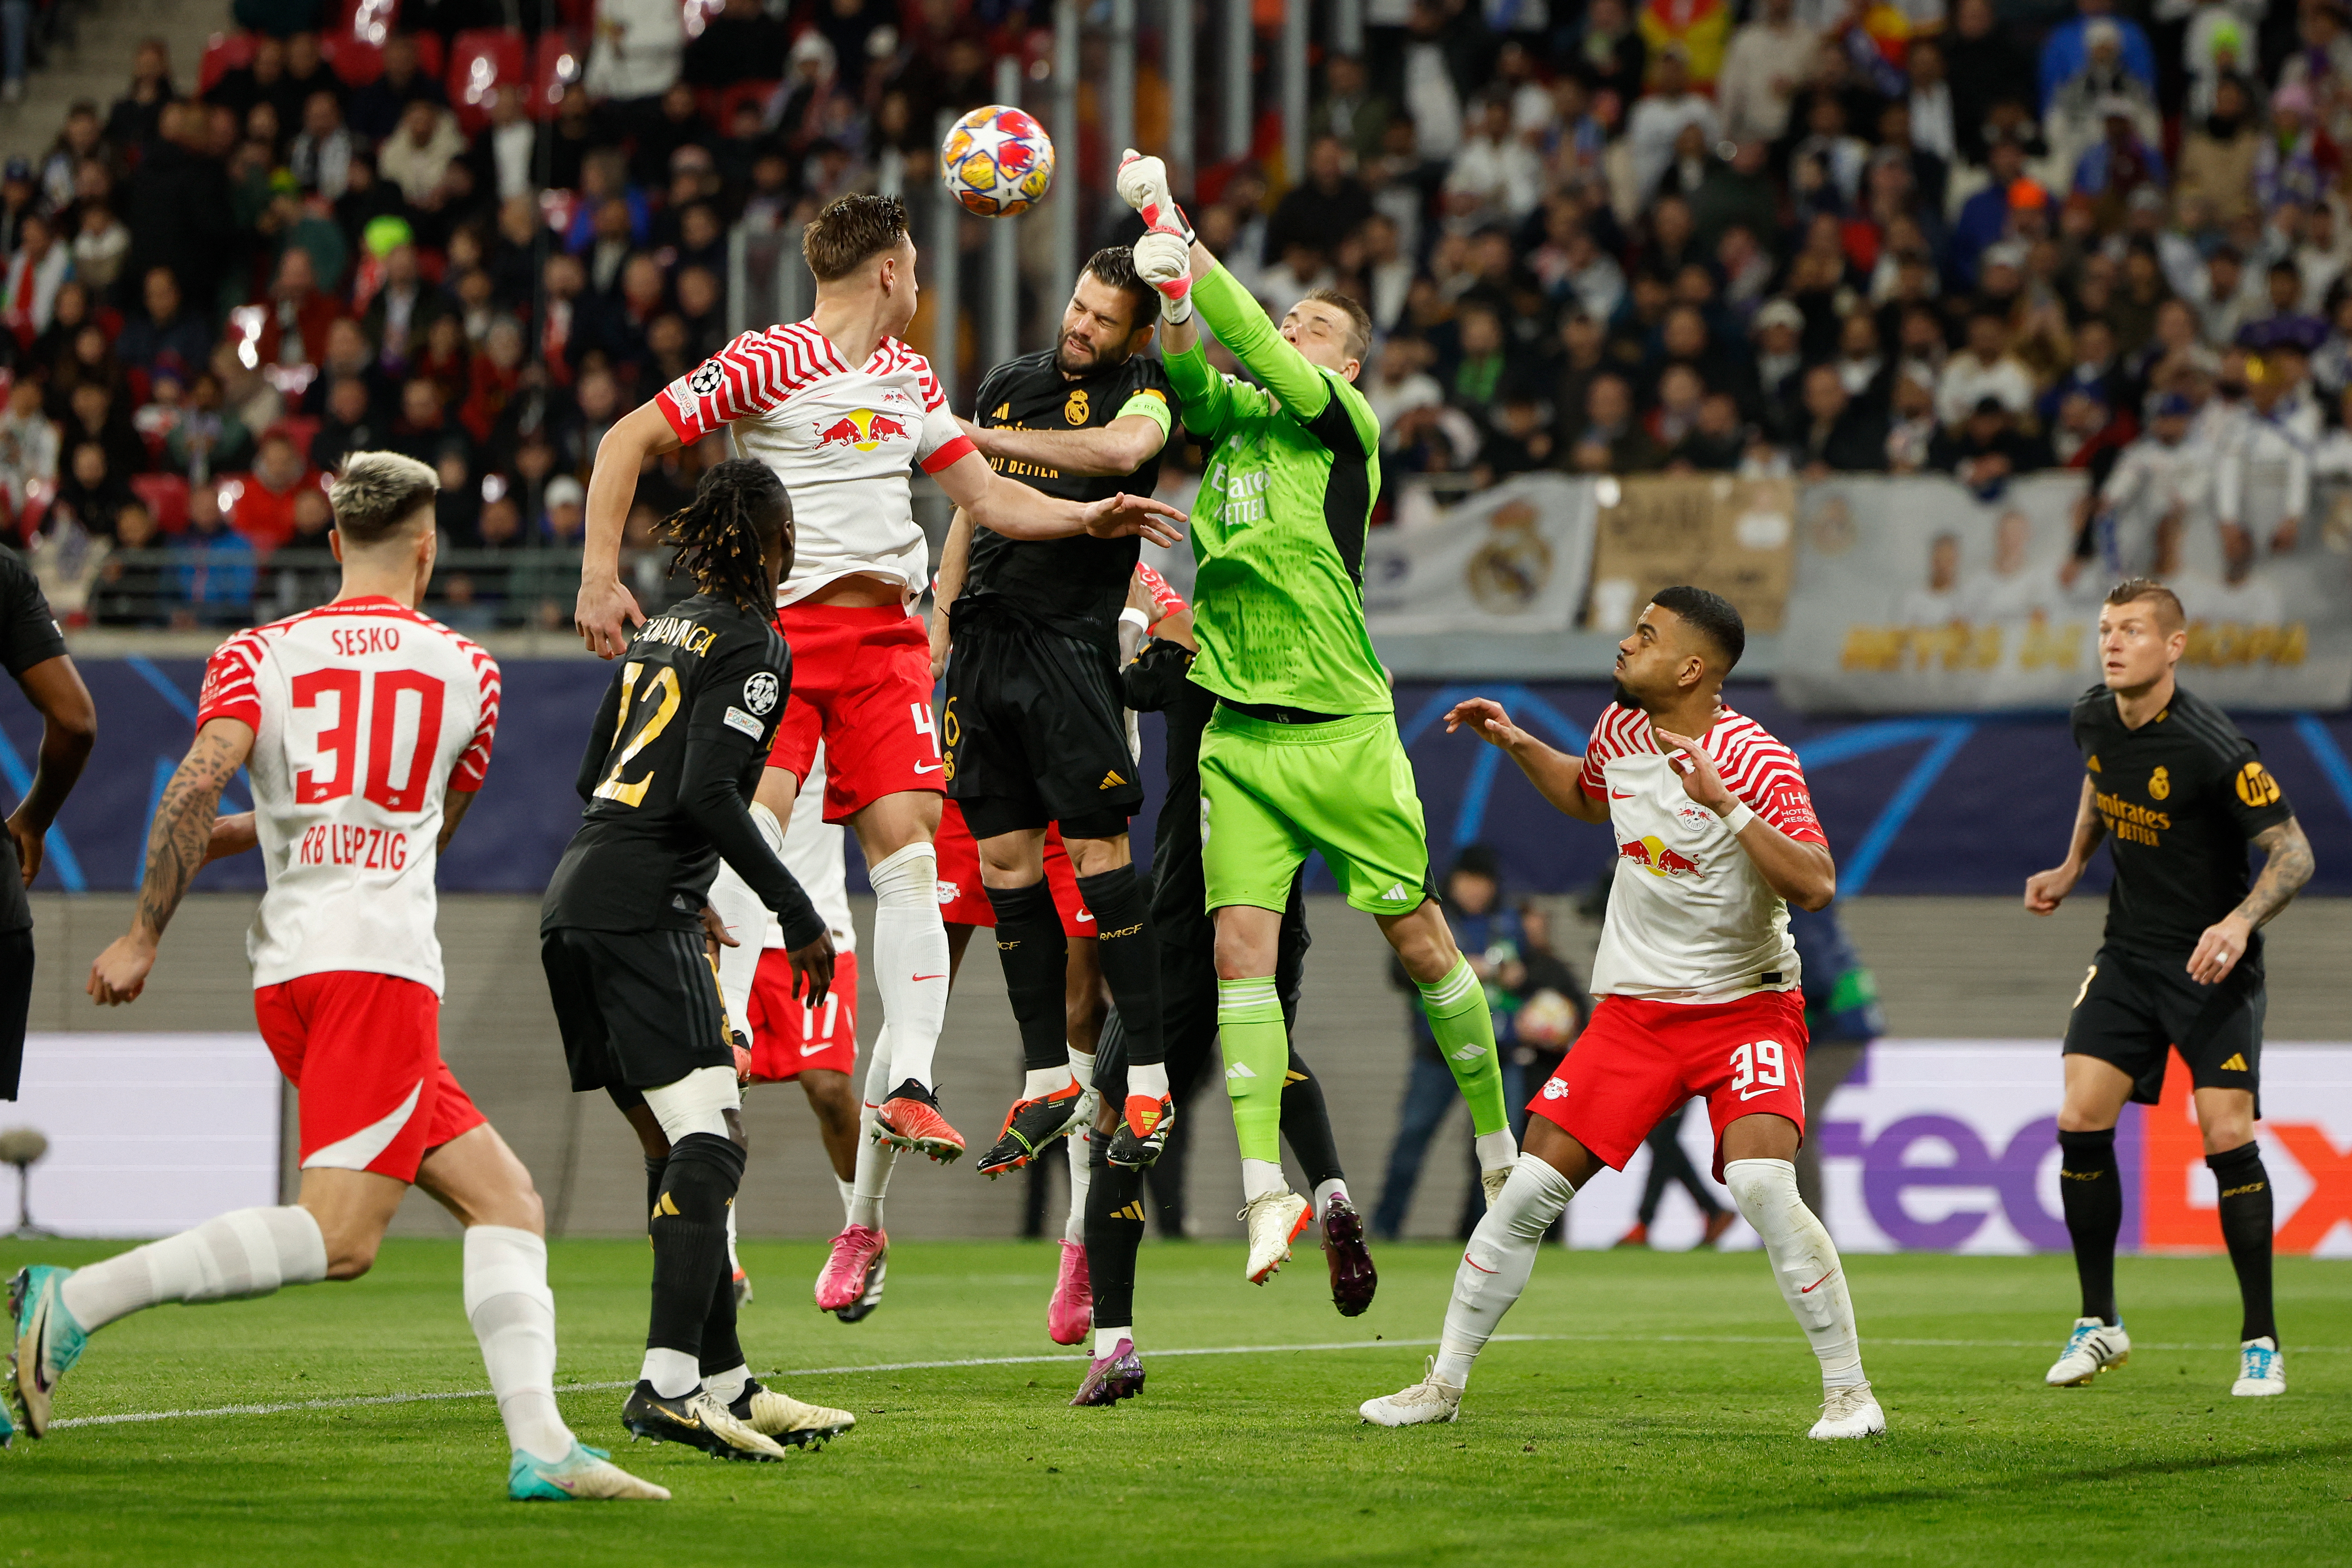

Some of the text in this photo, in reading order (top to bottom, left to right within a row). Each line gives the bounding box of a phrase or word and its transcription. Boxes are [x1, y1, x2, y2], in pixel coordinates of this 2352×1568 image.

[675, 382, 694, 413] NDATION
[1225, 497, 1265, 527] ETTER
[332, 627, 400, 657] SESKO
[292, 668, 445, 812] 30
[593, 662, 681, 808] 12
[910, 702, 941, 759] 4
[301, 825, 326, 864] RB
[997, 940, 1021, 950] CF
[801, 991, 839, 1041] 17
[1729, 1040, 1786, 1092] 39
